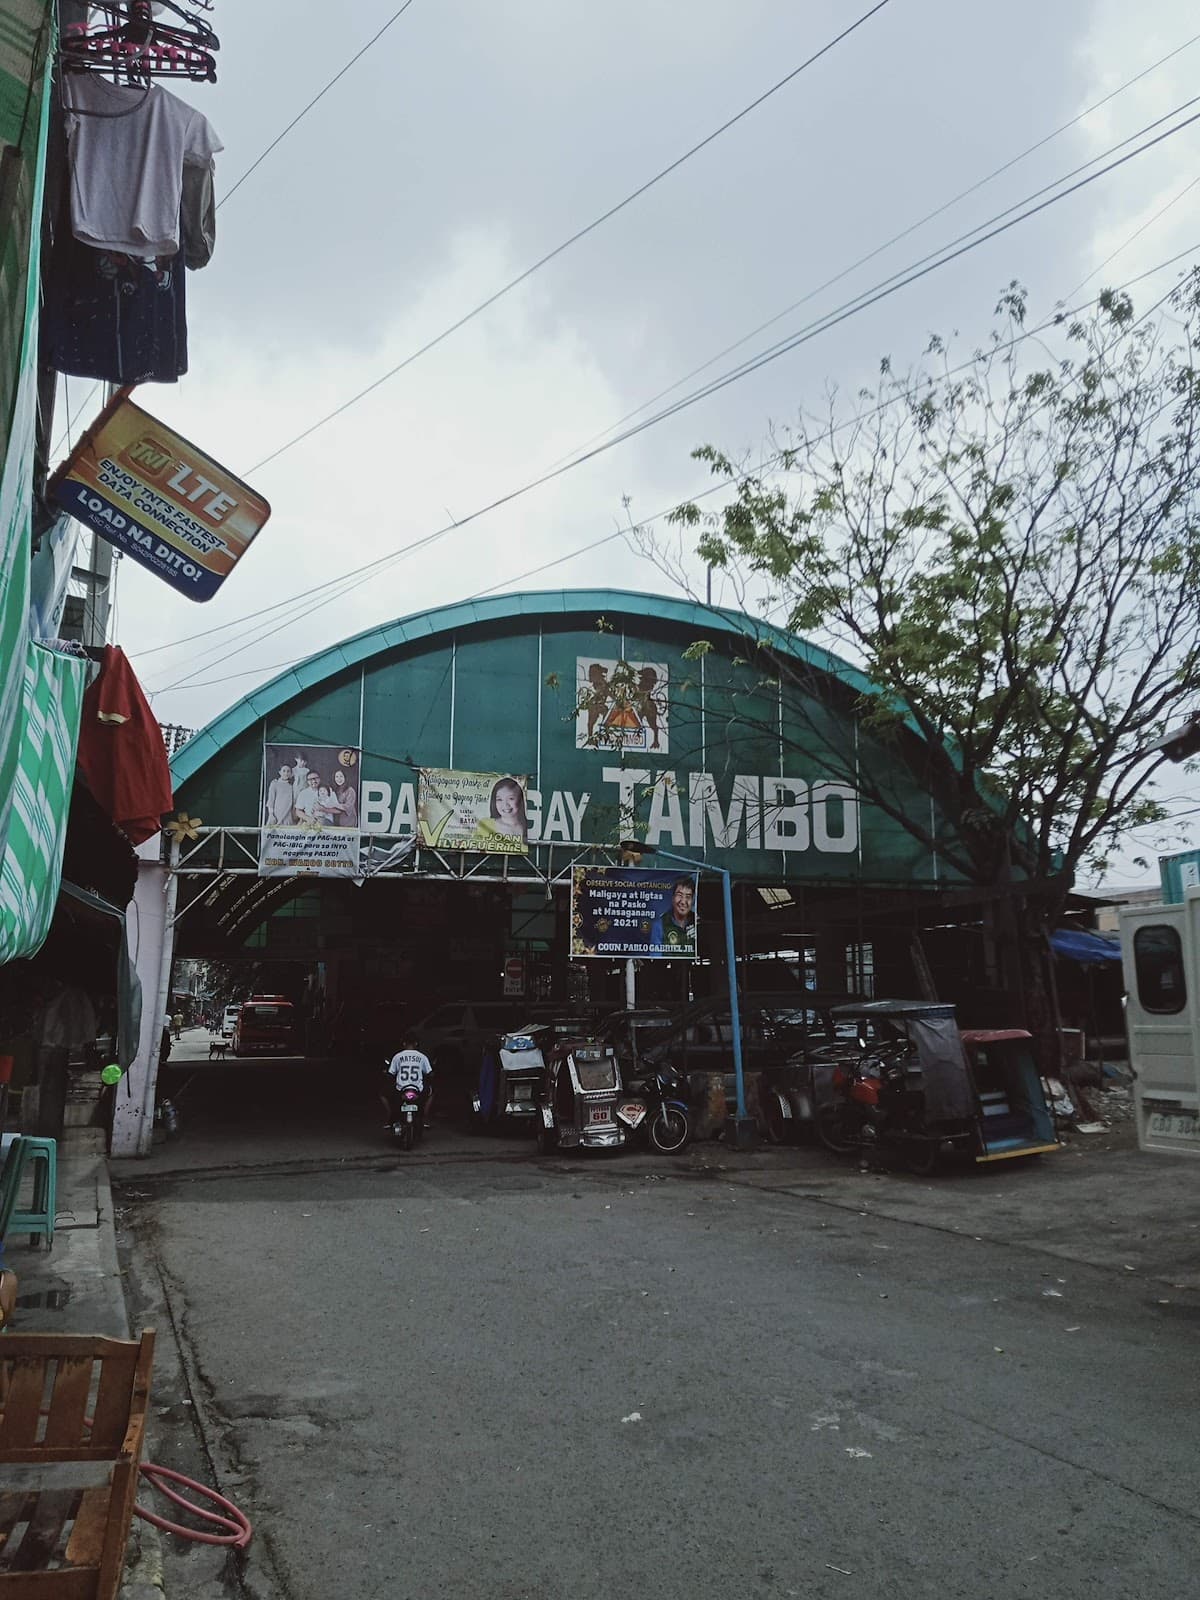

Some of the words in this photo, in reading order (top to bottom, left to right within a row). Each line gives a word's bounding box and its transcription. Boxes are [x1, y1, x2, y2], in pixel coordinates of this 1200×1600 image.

[128, 440, 176, 471] TNT
[166, 461, 238, 522] LTE
[100, 460, 141, 489] ENJOY
[141, 488, 175, 514] TNT'S
[173, 512, 225, 549] FASTEST
[97, 473, 133, 500] DATA
[133, 499, 210, 554] CONNECTION
[88, 514, 104, 527] ASC
[76, 489, 127, 530] LOAD
[127, 525, 154, 550] NA
[154, 545, 202, 582] DITO!
[361, 780, 591, 842] BAGAY
[602, 766, 859, 854] TAMBO
[317, 834, 346, 842] PAG-ASA
[486, 833, 522, 843] JOAN
[614, 880, 636, 888] SOCIAL
[589, 889, 627, 900] Maligaya
[629, 891, 638, 900] at
[640, 892, 664, 902] ligtas
[622, 900, 647, 909] Pasko
[592, 908, 602, 916] at
[604, 908, 656, 920] Masaganang
[613, 918, 638, 928] 2021!
[400, 1066, 420, 1082] 55
